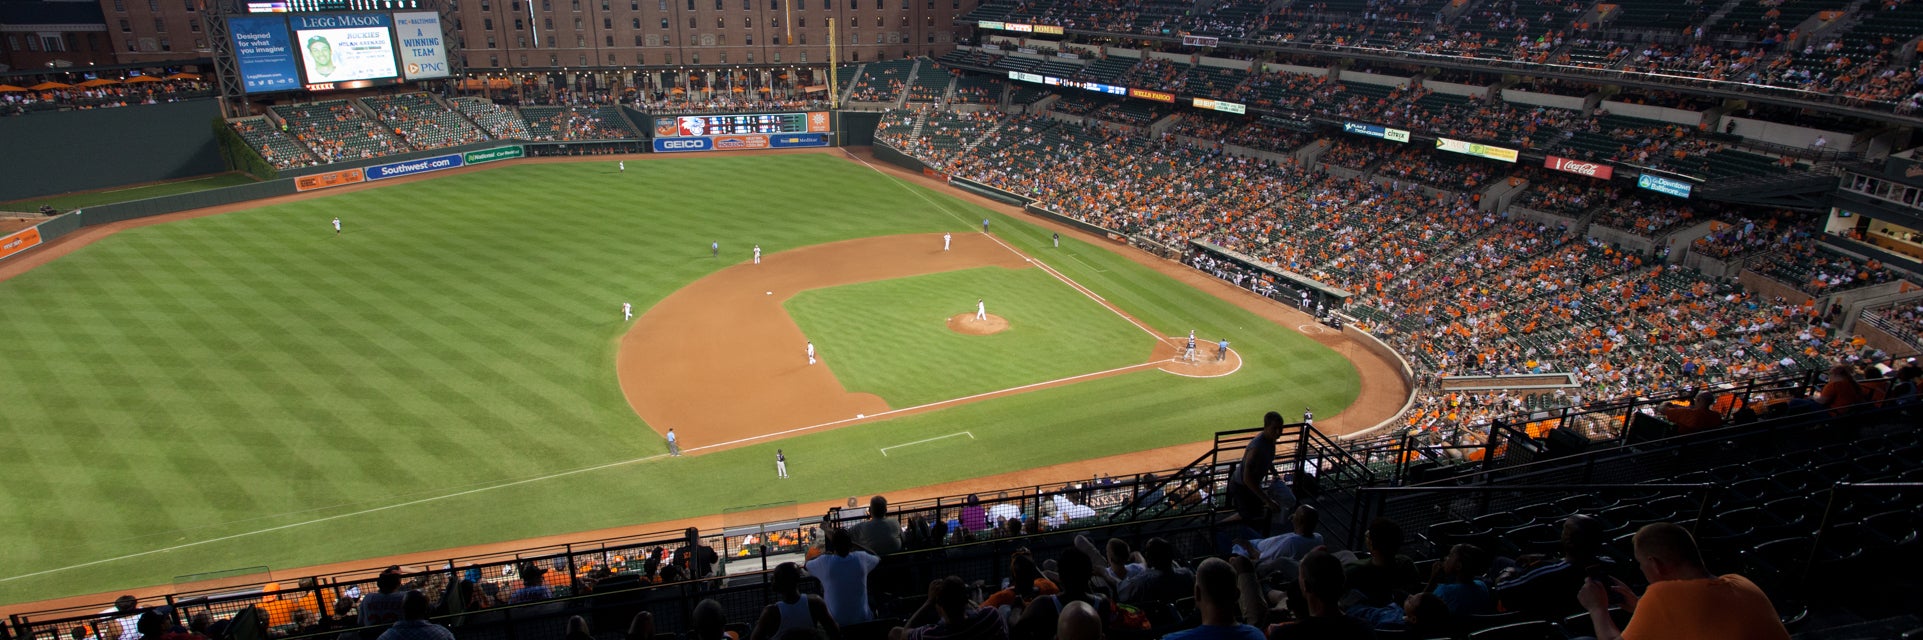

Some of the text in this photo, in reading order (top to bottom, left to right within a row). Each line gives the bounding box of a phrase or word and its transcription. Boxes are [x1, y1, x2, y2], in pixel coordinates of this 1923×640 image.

[302, 15, 380, 28] LEGG MASON
[236, 32, 271, 40] Designed
[417, 28, 424, 36] A
[403, 37, 440, 47] WINNING
[412, 48, 435, 57] TEAM
[421, 62, 444, 72] PNC
[1133, 89, 1151, 98] WELLS
[1152, 92, 1171, 101] FARGO
[664, 140, 704, 149] GEICO
[474, 152, 495, 160] National
[1563, 160, 1598, 176] Coca-Cola
